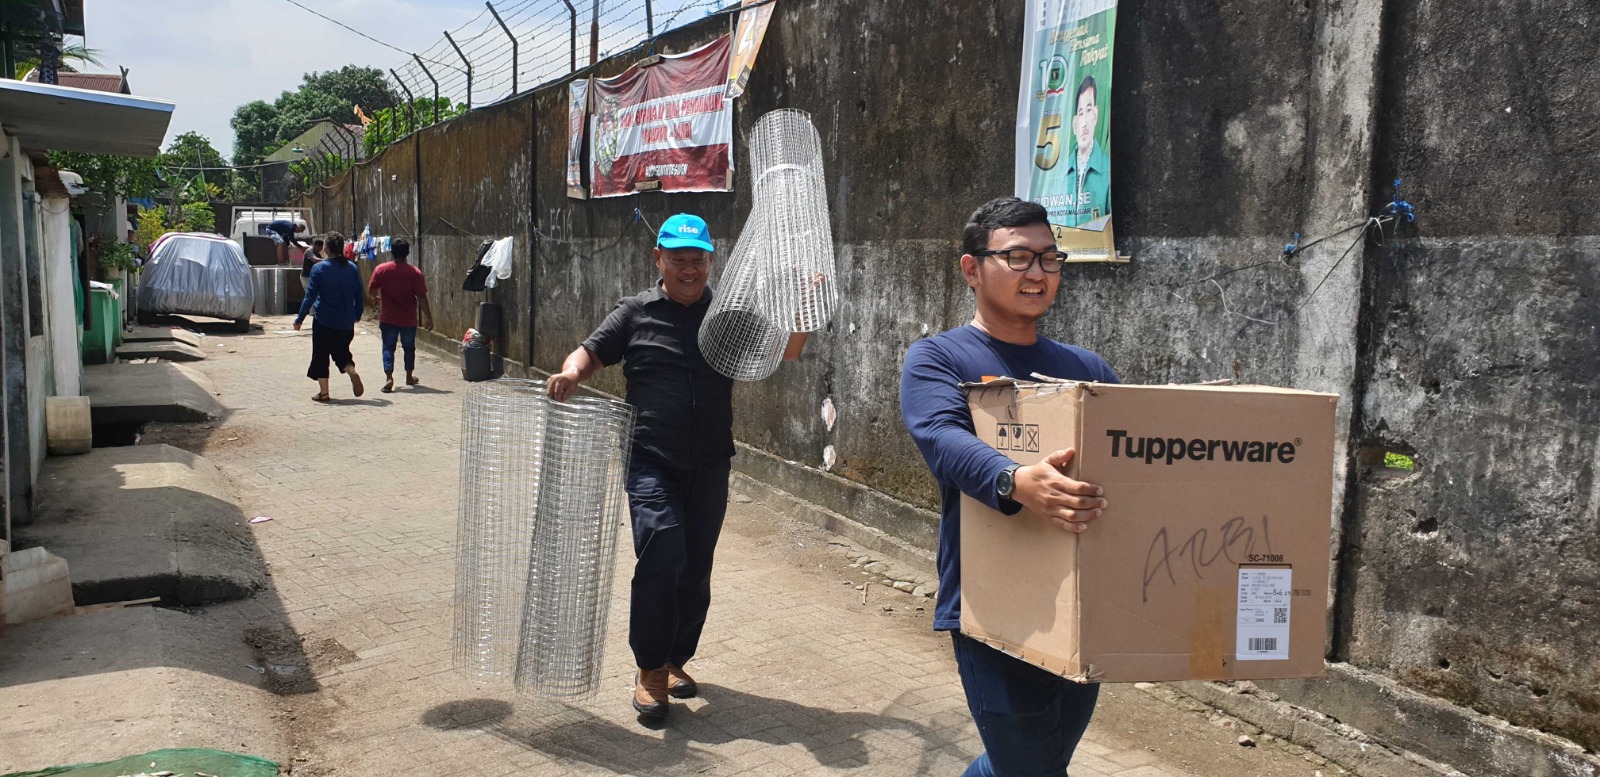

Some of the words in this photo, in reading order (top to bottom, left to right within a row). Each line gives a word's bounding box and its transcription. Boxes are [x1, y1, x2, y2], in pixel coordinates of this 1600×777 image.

[1079, 44, 1109, 67] Rakyat
[1034, 115, 1062, 171] 5
[1078, 192, 1091, 205] SE
[678, 224, 699, 234] rise
[1056, 227, 1063, 239] 2
[1106, 429, 1296, 465] Tupperware
[1248, 554, 1284, 562] SC-71008
